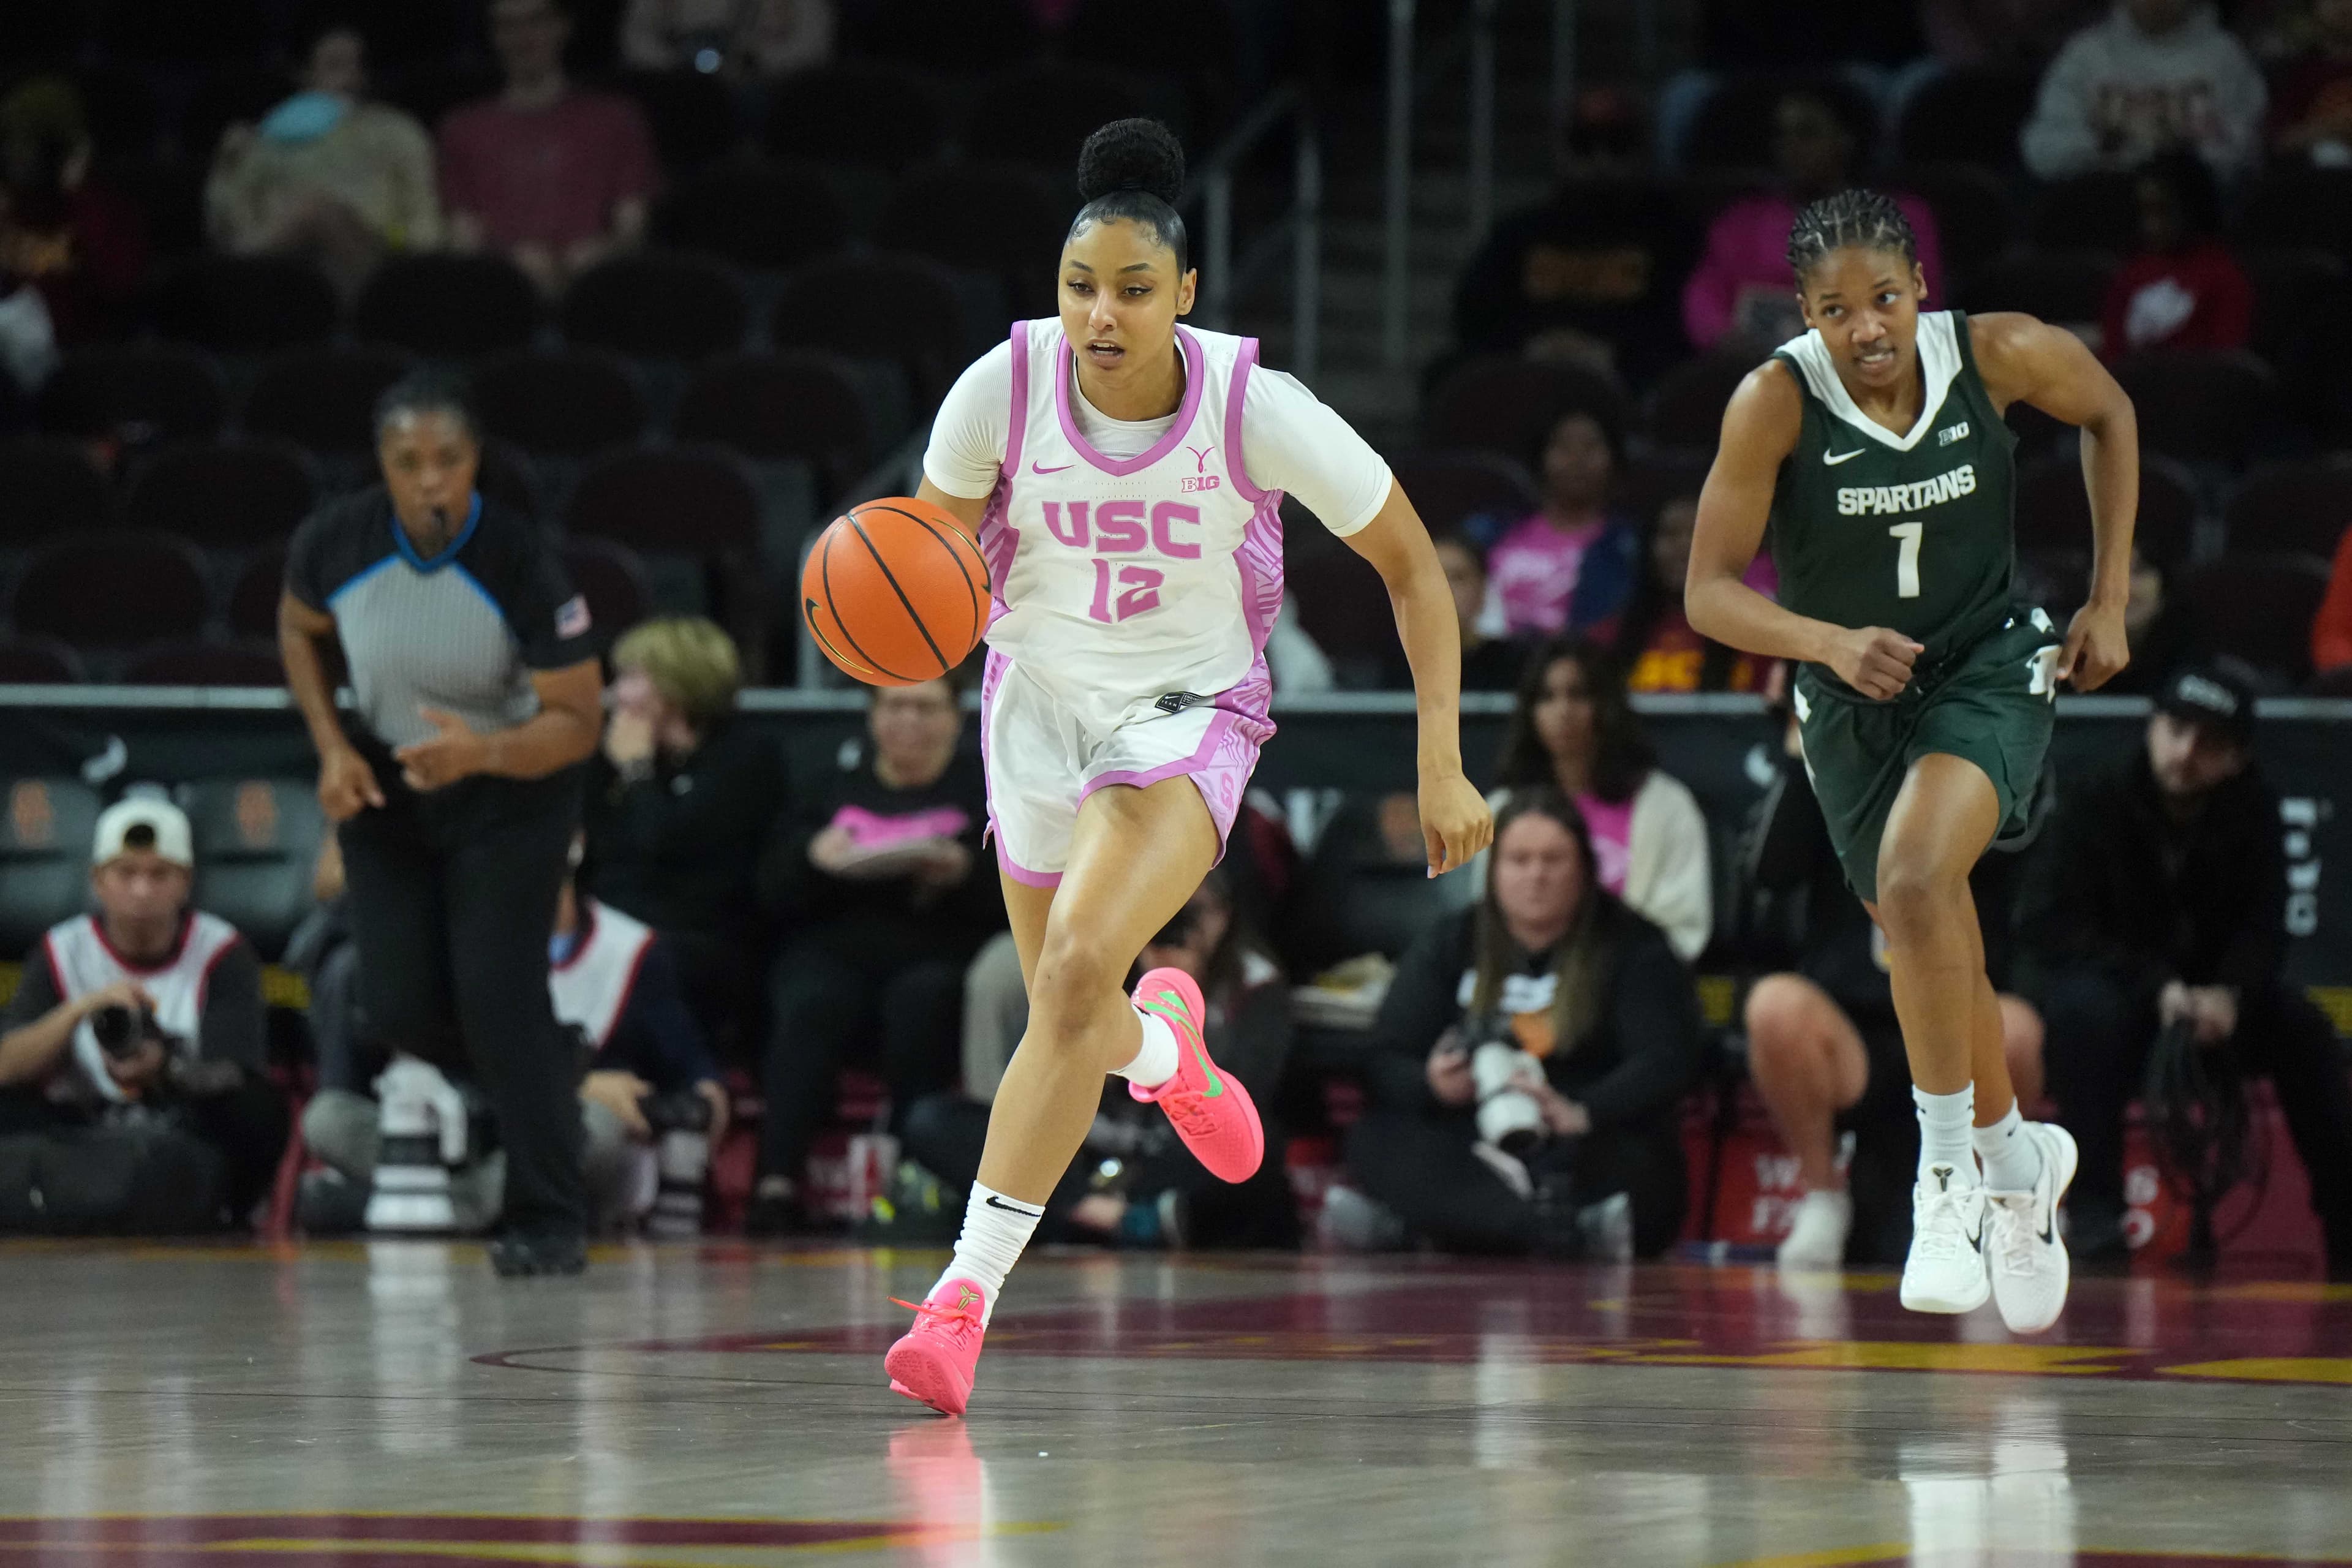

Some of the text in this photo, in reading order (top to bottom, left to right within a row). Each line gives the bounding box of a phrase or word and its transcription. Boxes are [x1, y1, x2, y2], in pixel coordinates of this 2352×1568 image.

[1838, 464, 1976, 516] SPARTANS
[1042, 500, 1202, 559] USC
[1889, 522, 1923, 598] 1
[1088, 558, 1164, 624] 12
